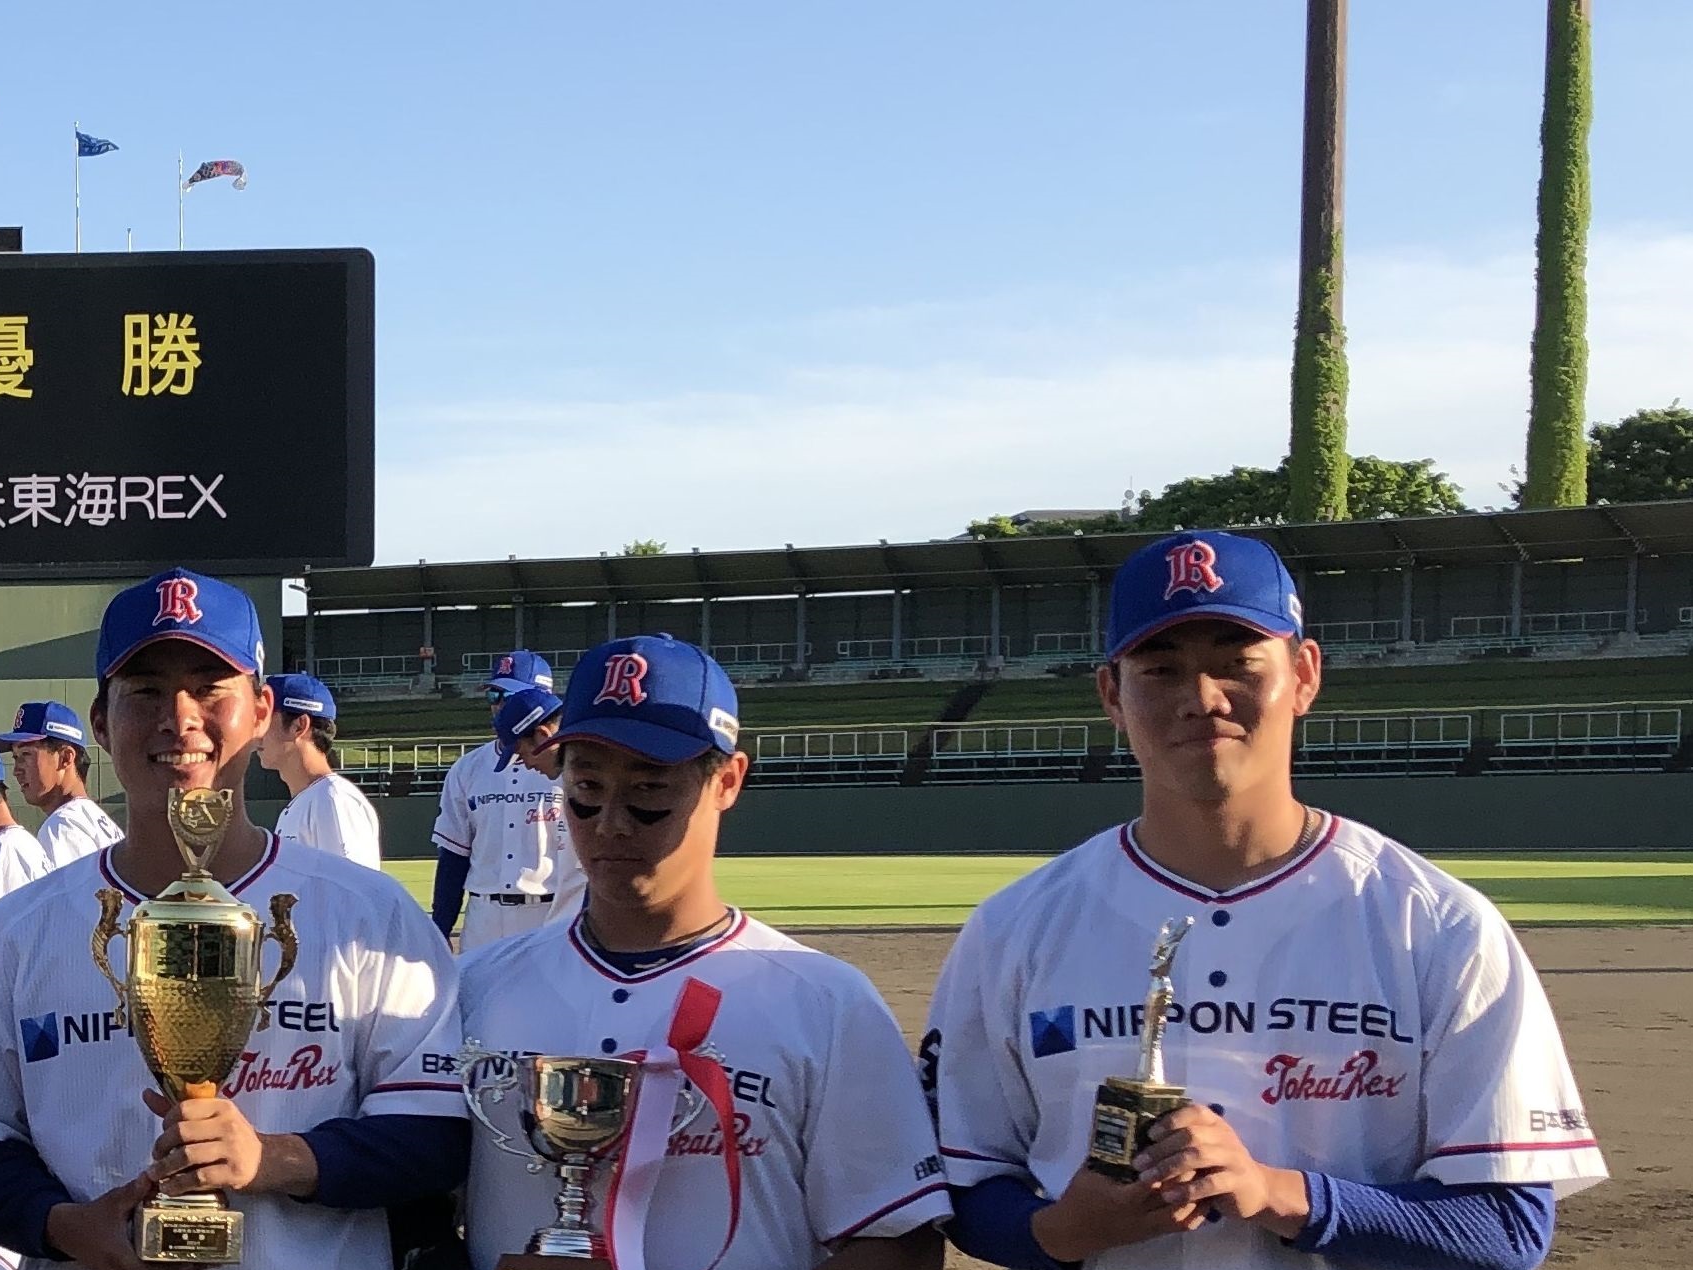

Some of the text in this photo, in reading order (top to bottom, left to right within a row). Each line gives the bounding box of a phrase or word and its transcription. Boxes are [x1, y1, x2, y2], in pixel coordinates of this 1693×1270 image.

[1164, 540, 1224, 600] R
[153, 577, 203, 626] R
[593, 653, 647, 706] R
[527, 792, 564, 803] STEE
[1267, 998, 1413, 1043] STEEL
